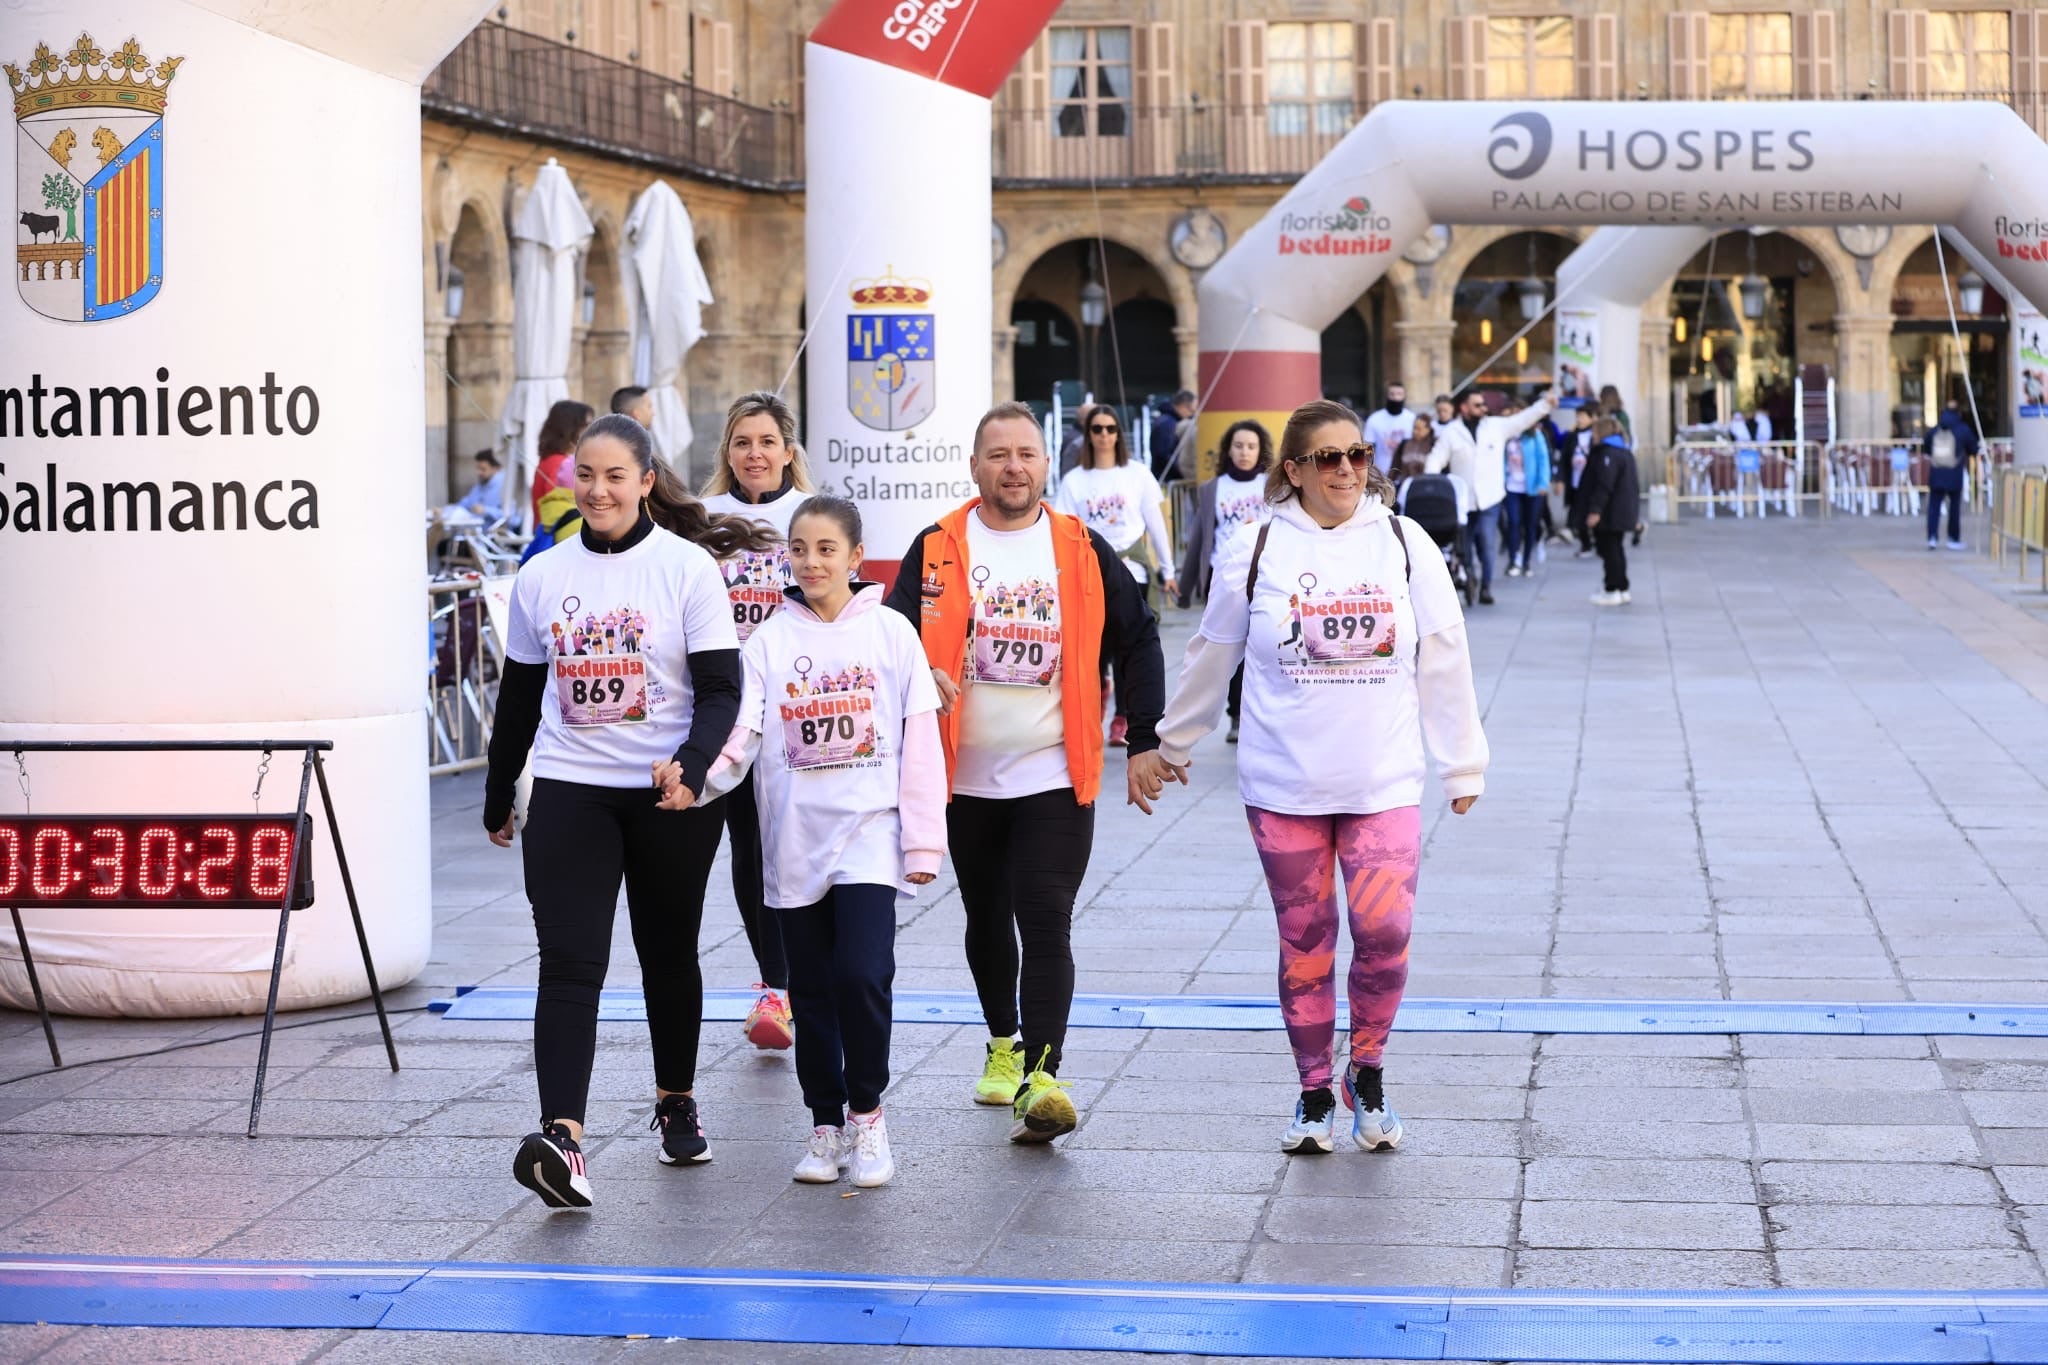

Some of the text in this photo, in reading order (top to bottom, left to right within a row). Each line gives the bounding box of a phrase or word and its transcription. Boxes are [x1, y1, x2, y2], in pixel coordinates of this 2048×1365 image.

[883, 0, 926, 40] CO
[1578, 130, 1815, 171] HOSPES
[1492, 191, 1902, 213] PALACIO DE SAN ESTEBAN
[1278, 233, 1392, 255] bedunia
[828, 438, 961, 468] Diputación
[843, 476, 971, 500] Salamanca
[730, 587, 783, 604] eduni
[1301, 599, 1393, 617] bedunia
[976, 621, 1061, 644] bedunia
[1322, 615, 1376, 640] 899
[993, 640, 1044, 666] 790
[556, 658, 644, 678] bedunia
[1353, 668, 1398, 676] SALAMANCA
[572, 677, 625, 704] 869
[779, 695, 872, 721] bedunia
[801, 715, 855, 745] 870
[866, 760, 882, 768] 2025
